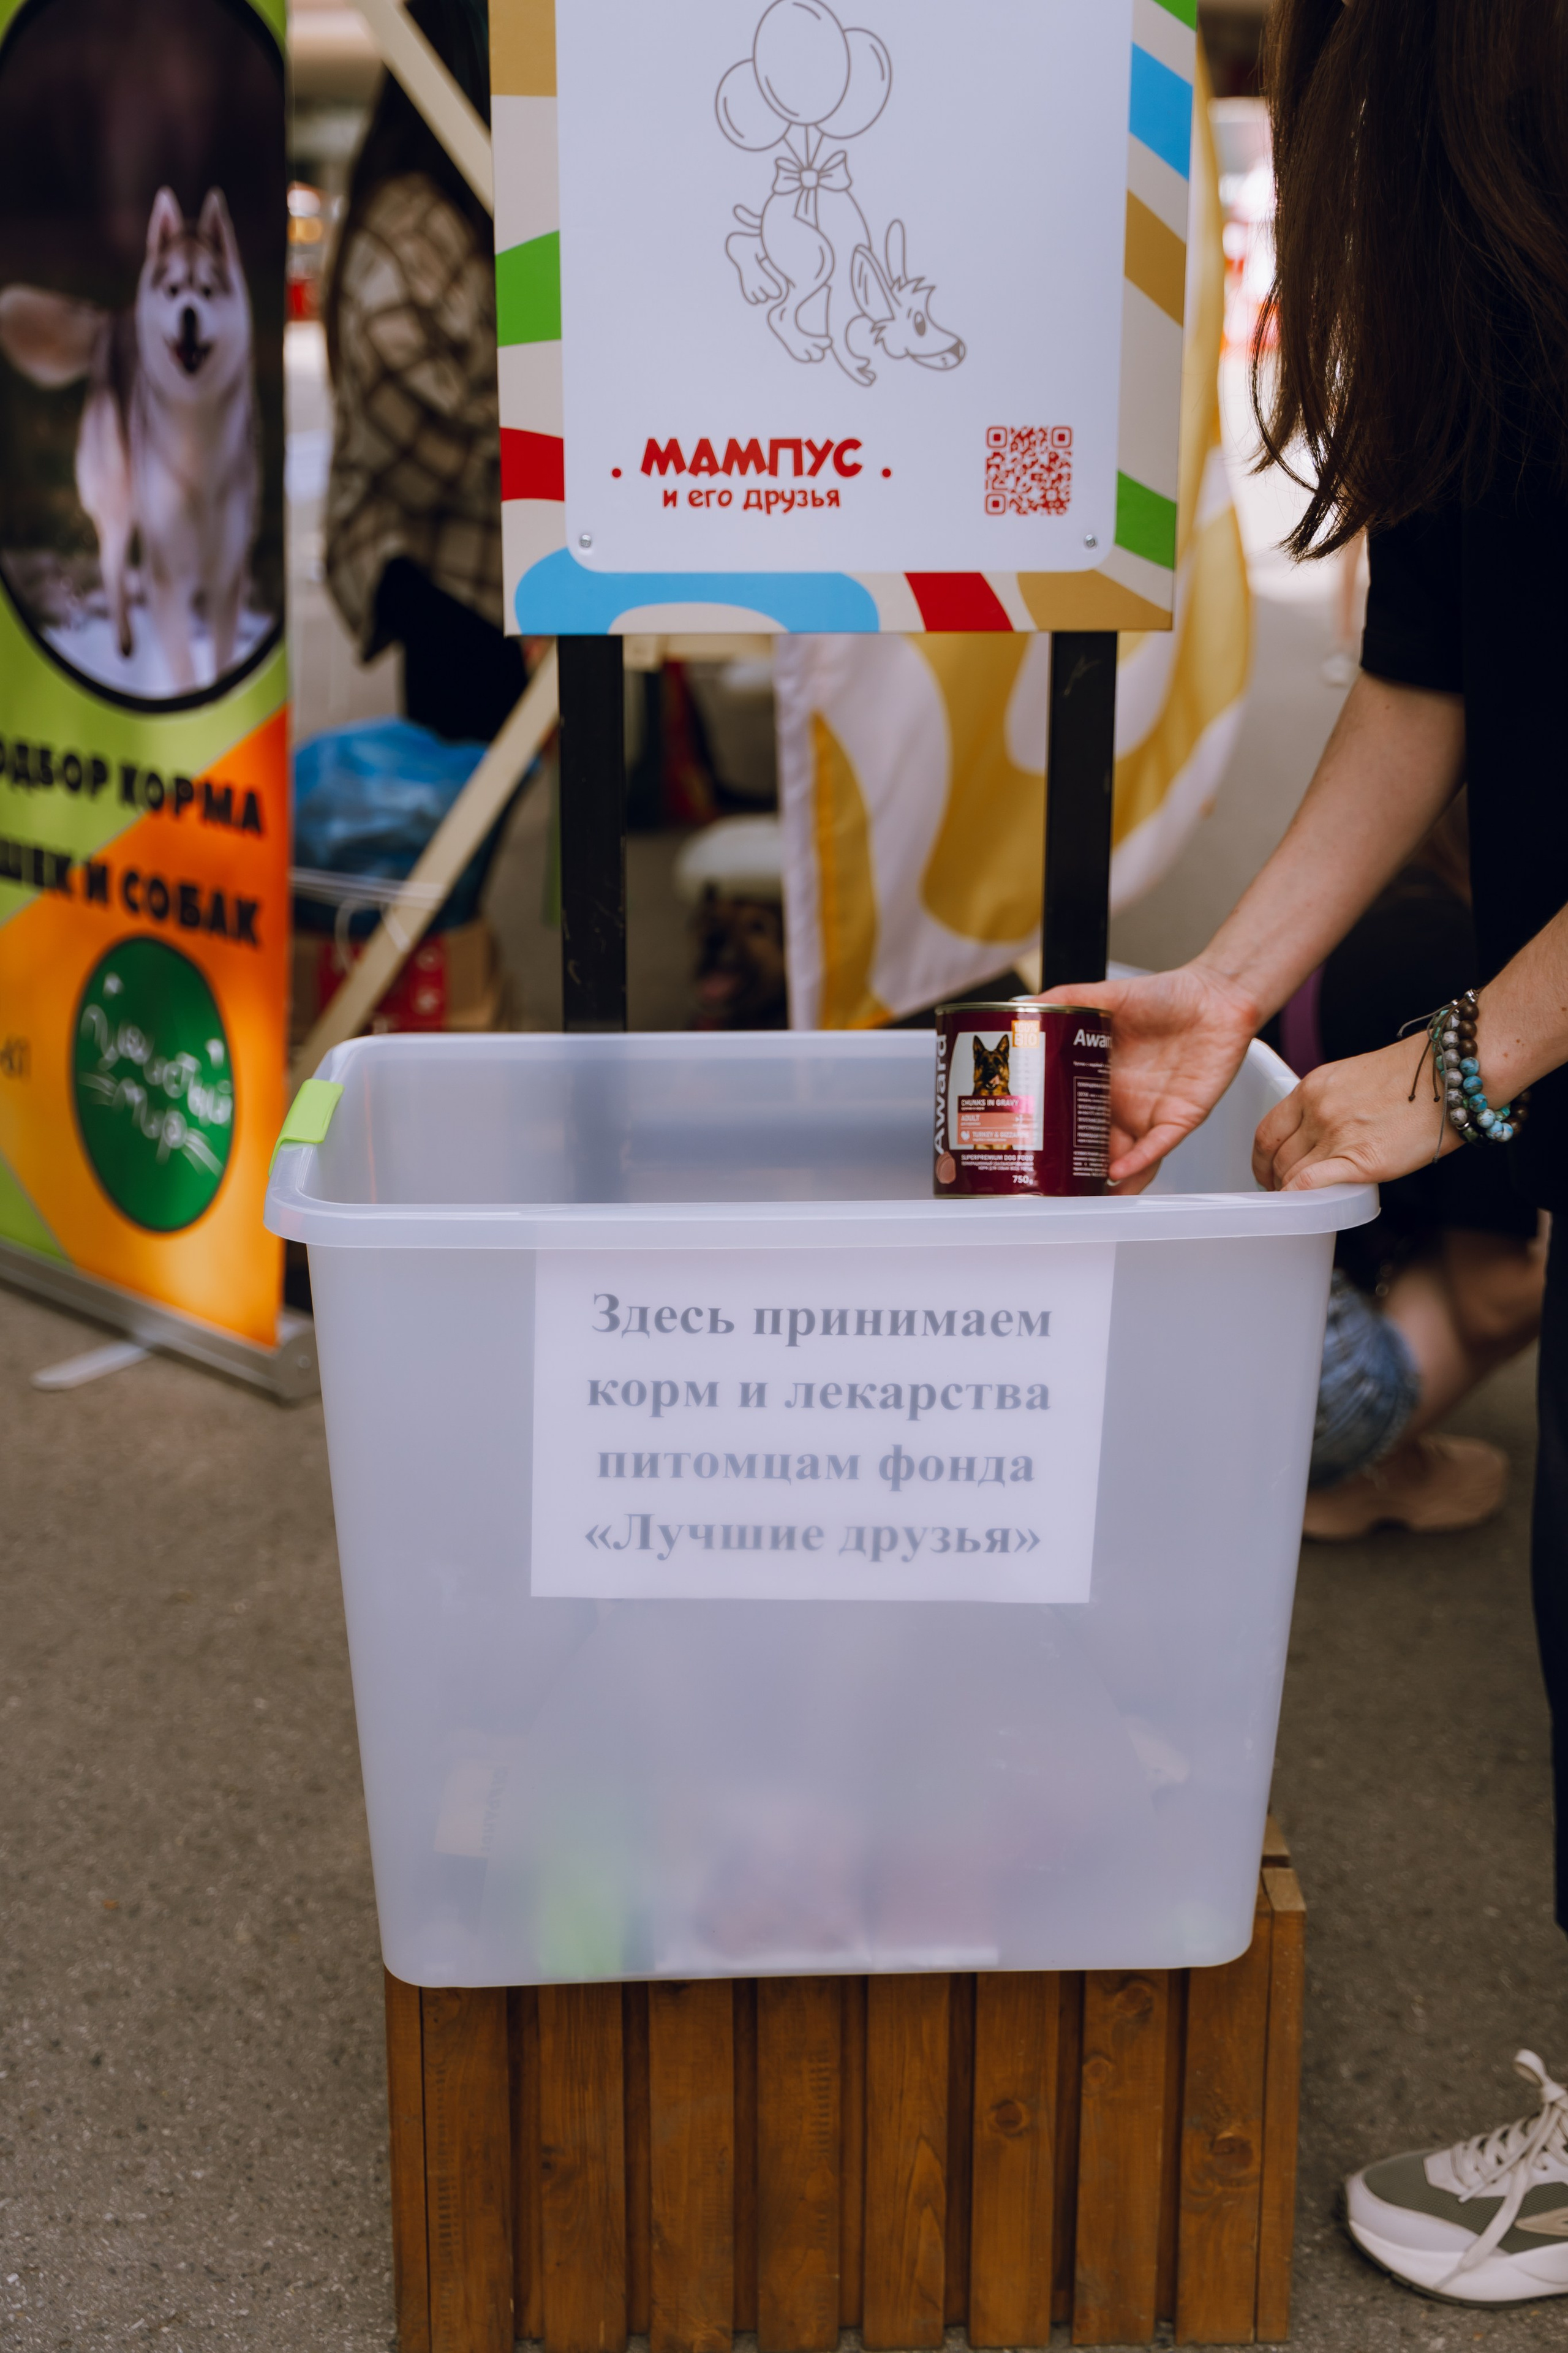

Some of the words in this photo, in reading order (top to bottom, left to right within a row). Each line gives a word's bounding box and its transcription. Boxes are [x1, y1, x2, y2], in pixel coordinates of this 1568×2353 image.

[640, 438, 863, 478] МАМПУС
[663, 489, 677, 507] и
[688, 489, 733, 507] его
[743, 488, 840, 515] друзья
[0, 739, 109, 795] ДБОР
[119, 764, 263, 834] КОРМА
[86, 860, 109, 905] И
[123, 871, 258, 946] СОБАК
[1014, 1033, 1038, 1046] BIO
[591, 1293, 734, 1339] Здесь
[753, 1306, 1052, 1347] принимаем
[587, 1378, 719, 1418] корм
[738, 1381, 767, 1408] и
[785, 1382, 1051, 1421] лекарства
[597, 1450, 861, 1485] питомцам
[878, 1444, 1035, 1492] фонда
[584, 1513, 824, 1561] «Лучшие
[839, 1524, 1041, 1563] друзья»
